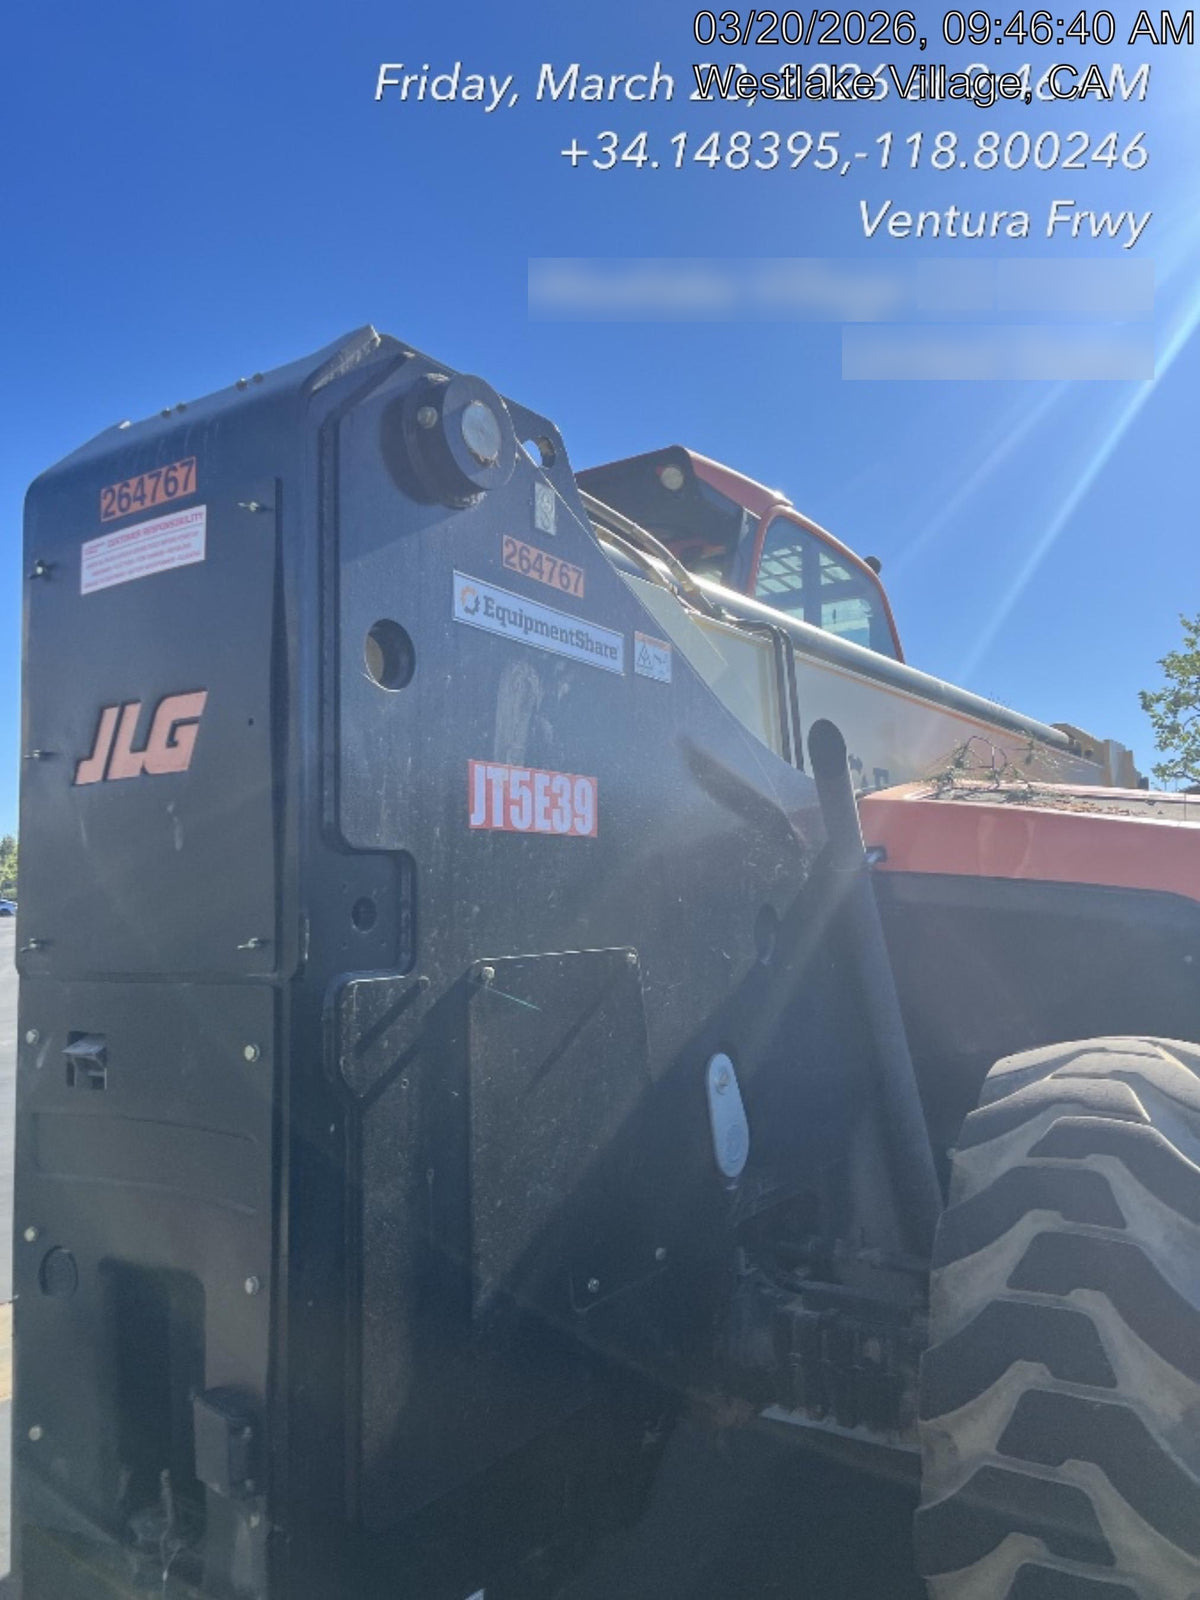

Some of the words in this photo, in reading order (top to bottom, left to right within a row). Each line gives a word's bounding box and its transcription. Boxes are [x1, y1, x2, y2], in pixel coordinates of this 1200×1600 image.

[102, 460, 195, 518] 264767
[504, 539, 583, 595] 264767
[481, 594, 619, 662] EquipmentShare
[74, 690, 208, 786] JLG
[470, 764, 594, 836] JT5E39
